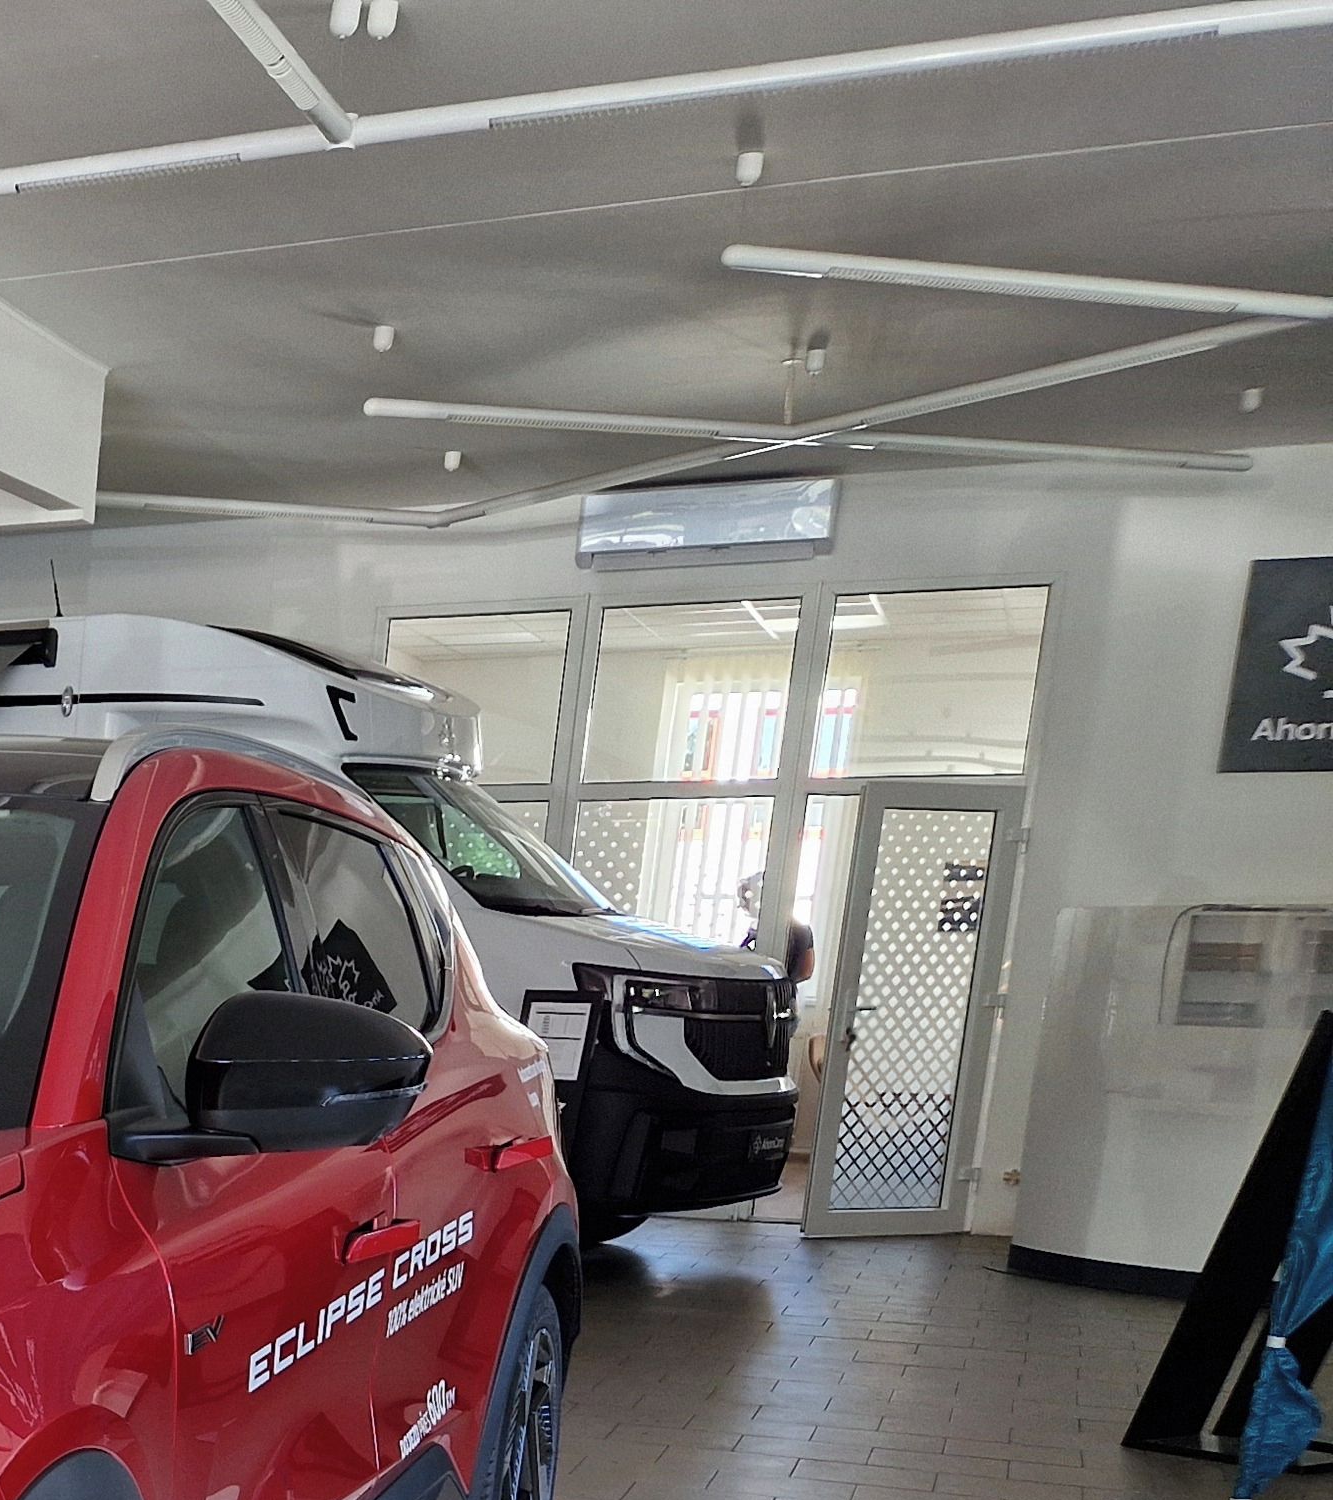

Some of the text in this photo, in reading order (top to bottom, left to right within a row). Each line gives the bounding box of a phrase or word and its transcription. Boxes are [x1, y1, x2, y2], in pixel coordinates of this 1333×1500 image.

[1250, 717, 1333, 741] Ahor
[446, 1260, 465, 1296] SUV
[248, 1210, 474, 1394] ECLIPSE CROSS
[426, 1379, 447, 1426] 600
